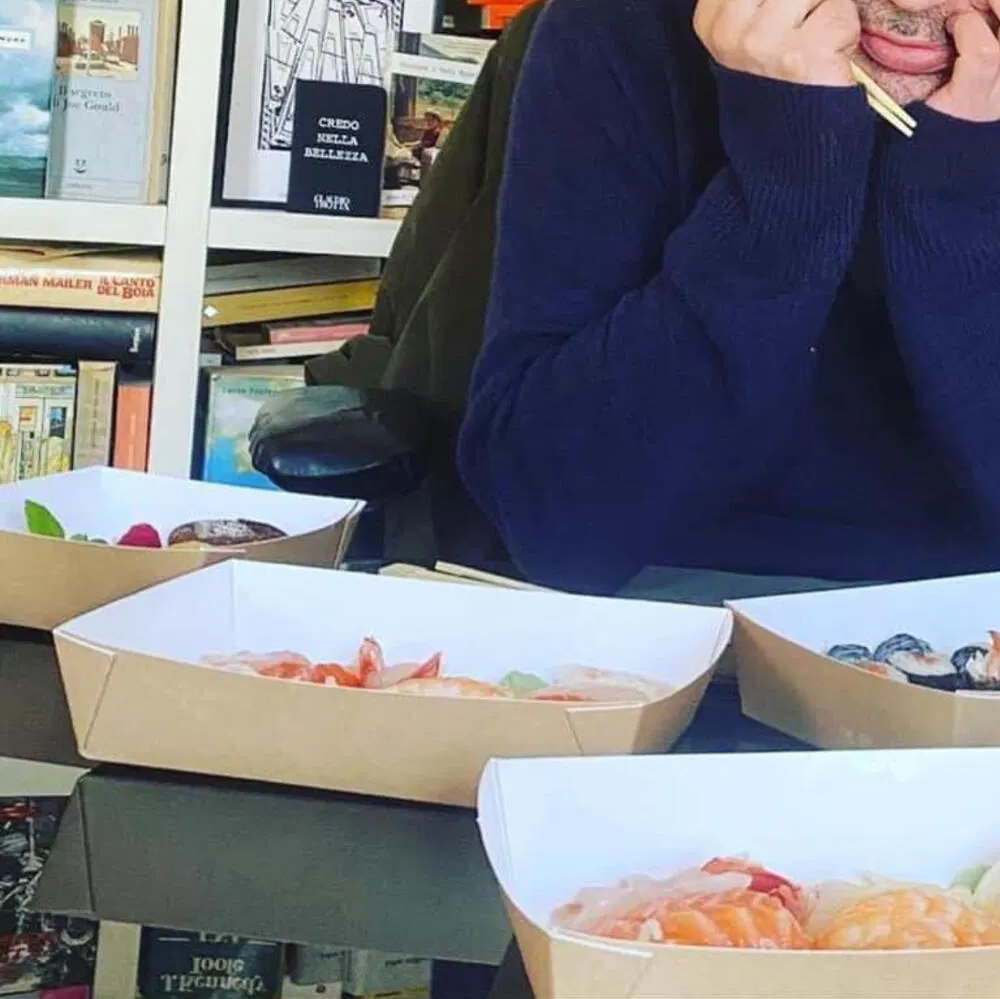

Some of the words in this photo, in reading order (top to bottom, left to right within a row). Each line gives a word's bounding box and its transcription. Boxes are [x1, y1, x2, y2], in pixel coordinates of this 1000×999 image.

[319, 116, 361, 131] CREDO
[316, 132, 359, 147] NELLA
[303, 147, 369, 163] BELLEZZA
[42, 276, 93, 290] MAILER
